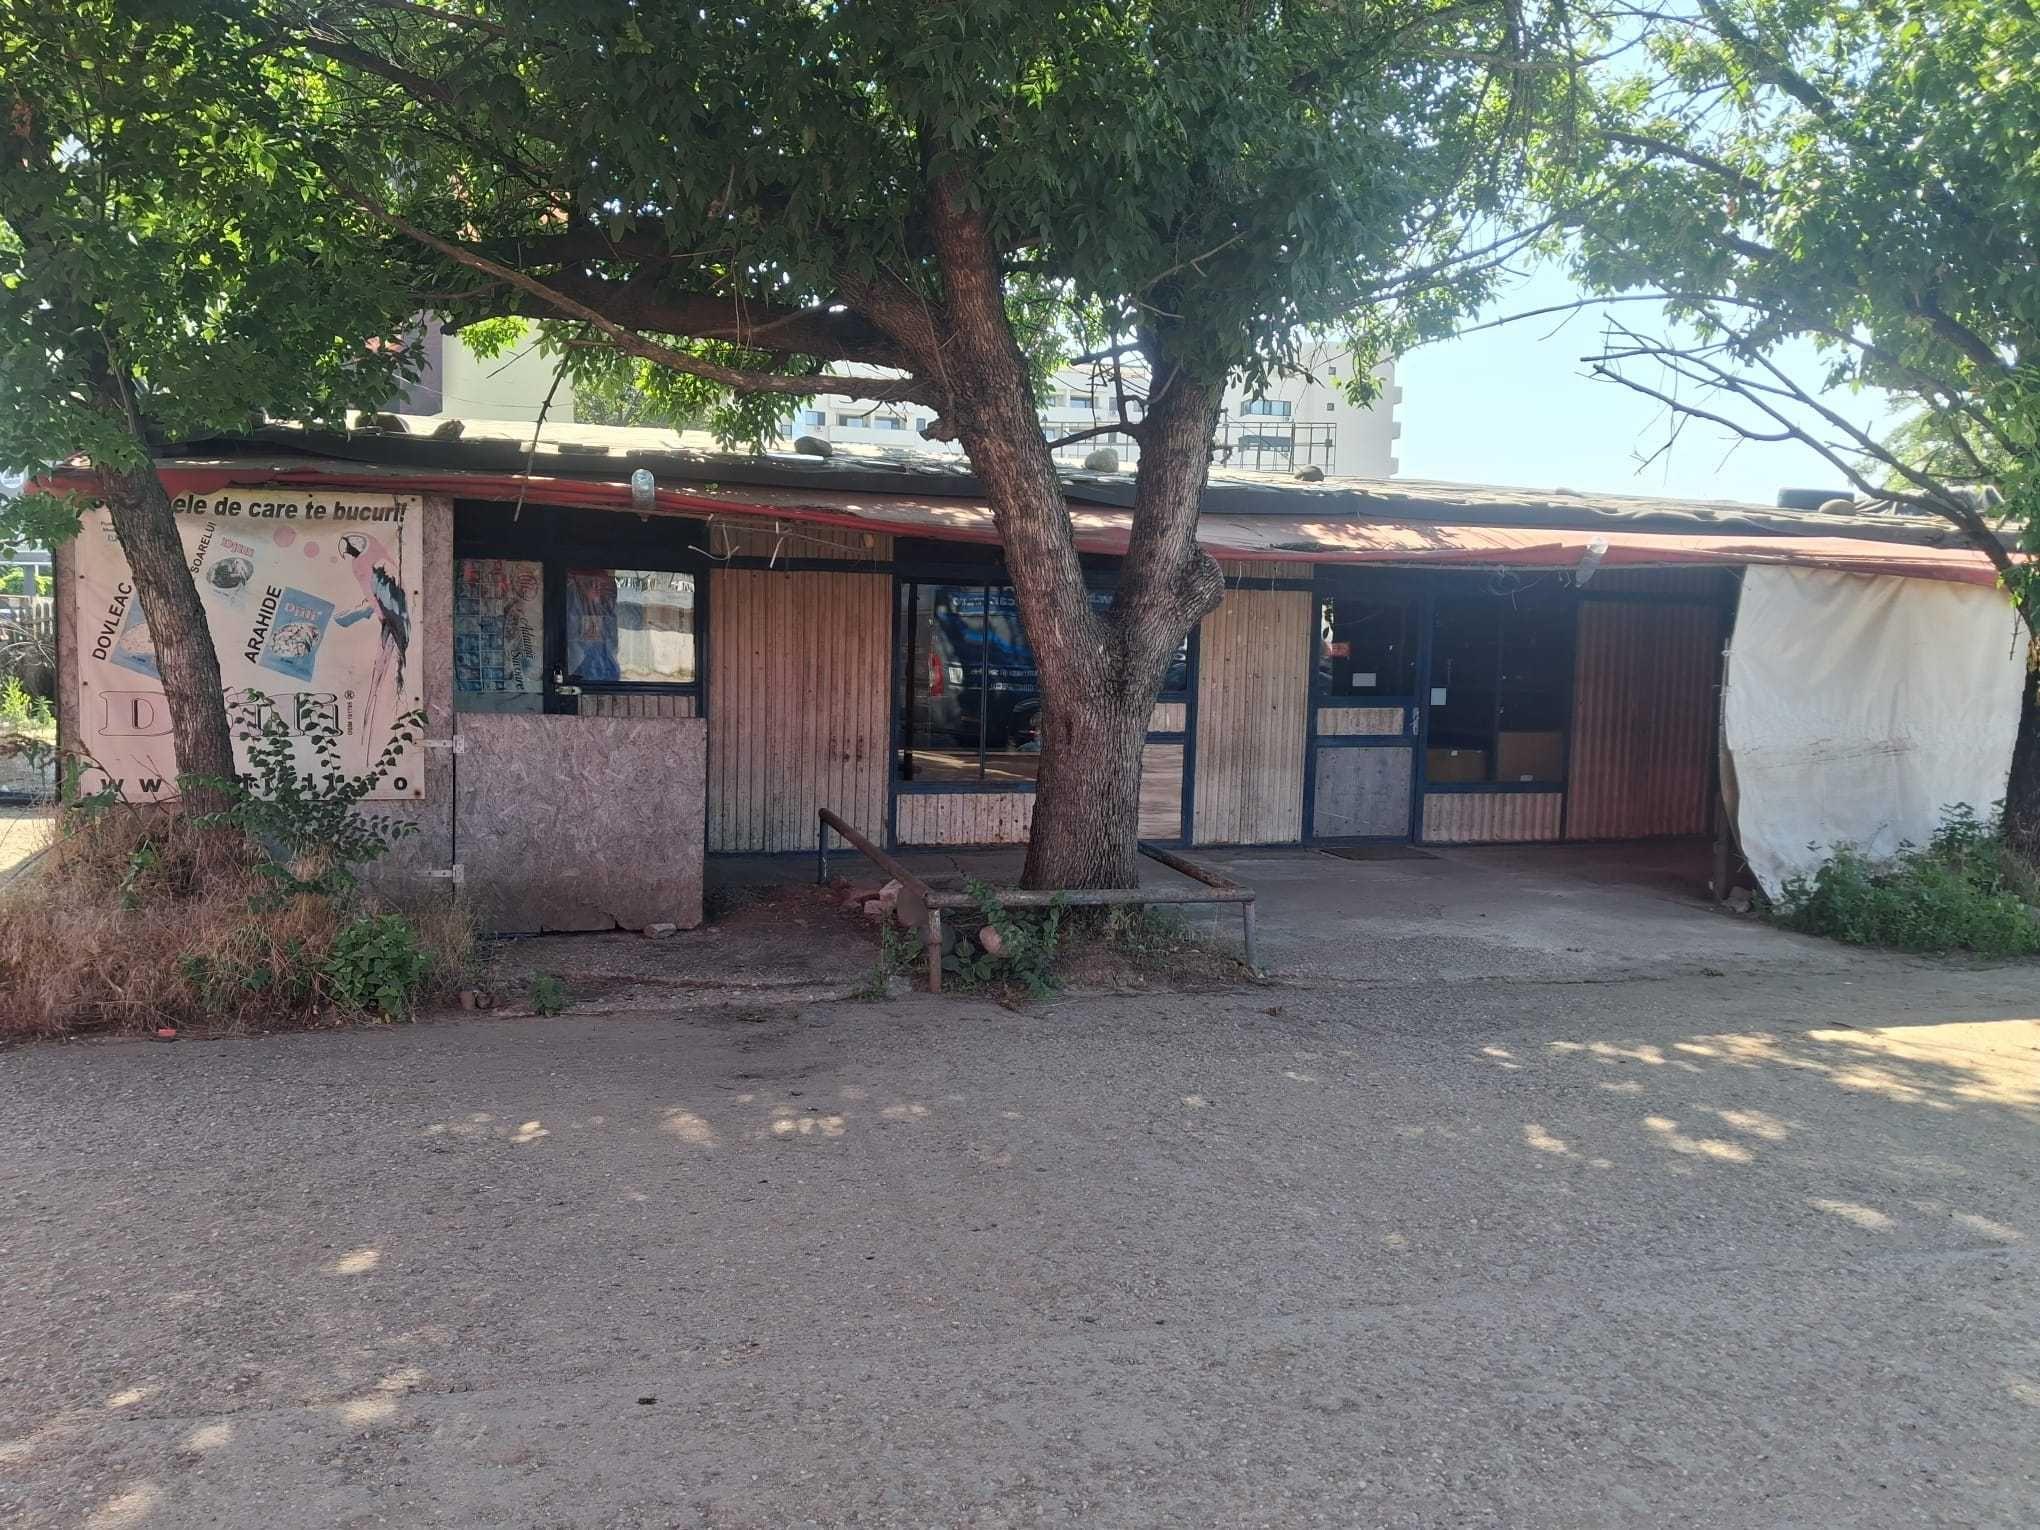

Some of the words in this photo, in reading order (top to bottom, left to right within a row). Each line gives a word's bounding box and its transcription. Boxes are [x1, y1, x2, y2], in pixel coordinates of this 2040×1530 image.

[172, 495, 207, 514] ele
[214, 497, 241, 517] de
[248, 501, 298, 519] care
[305, 501, 327, 520] te
[190, 521, 217, 574] SOARELUI
[92, 582, 132, 661] DOVLEAC
[244, 585, 282, 664] ARAHIDE
